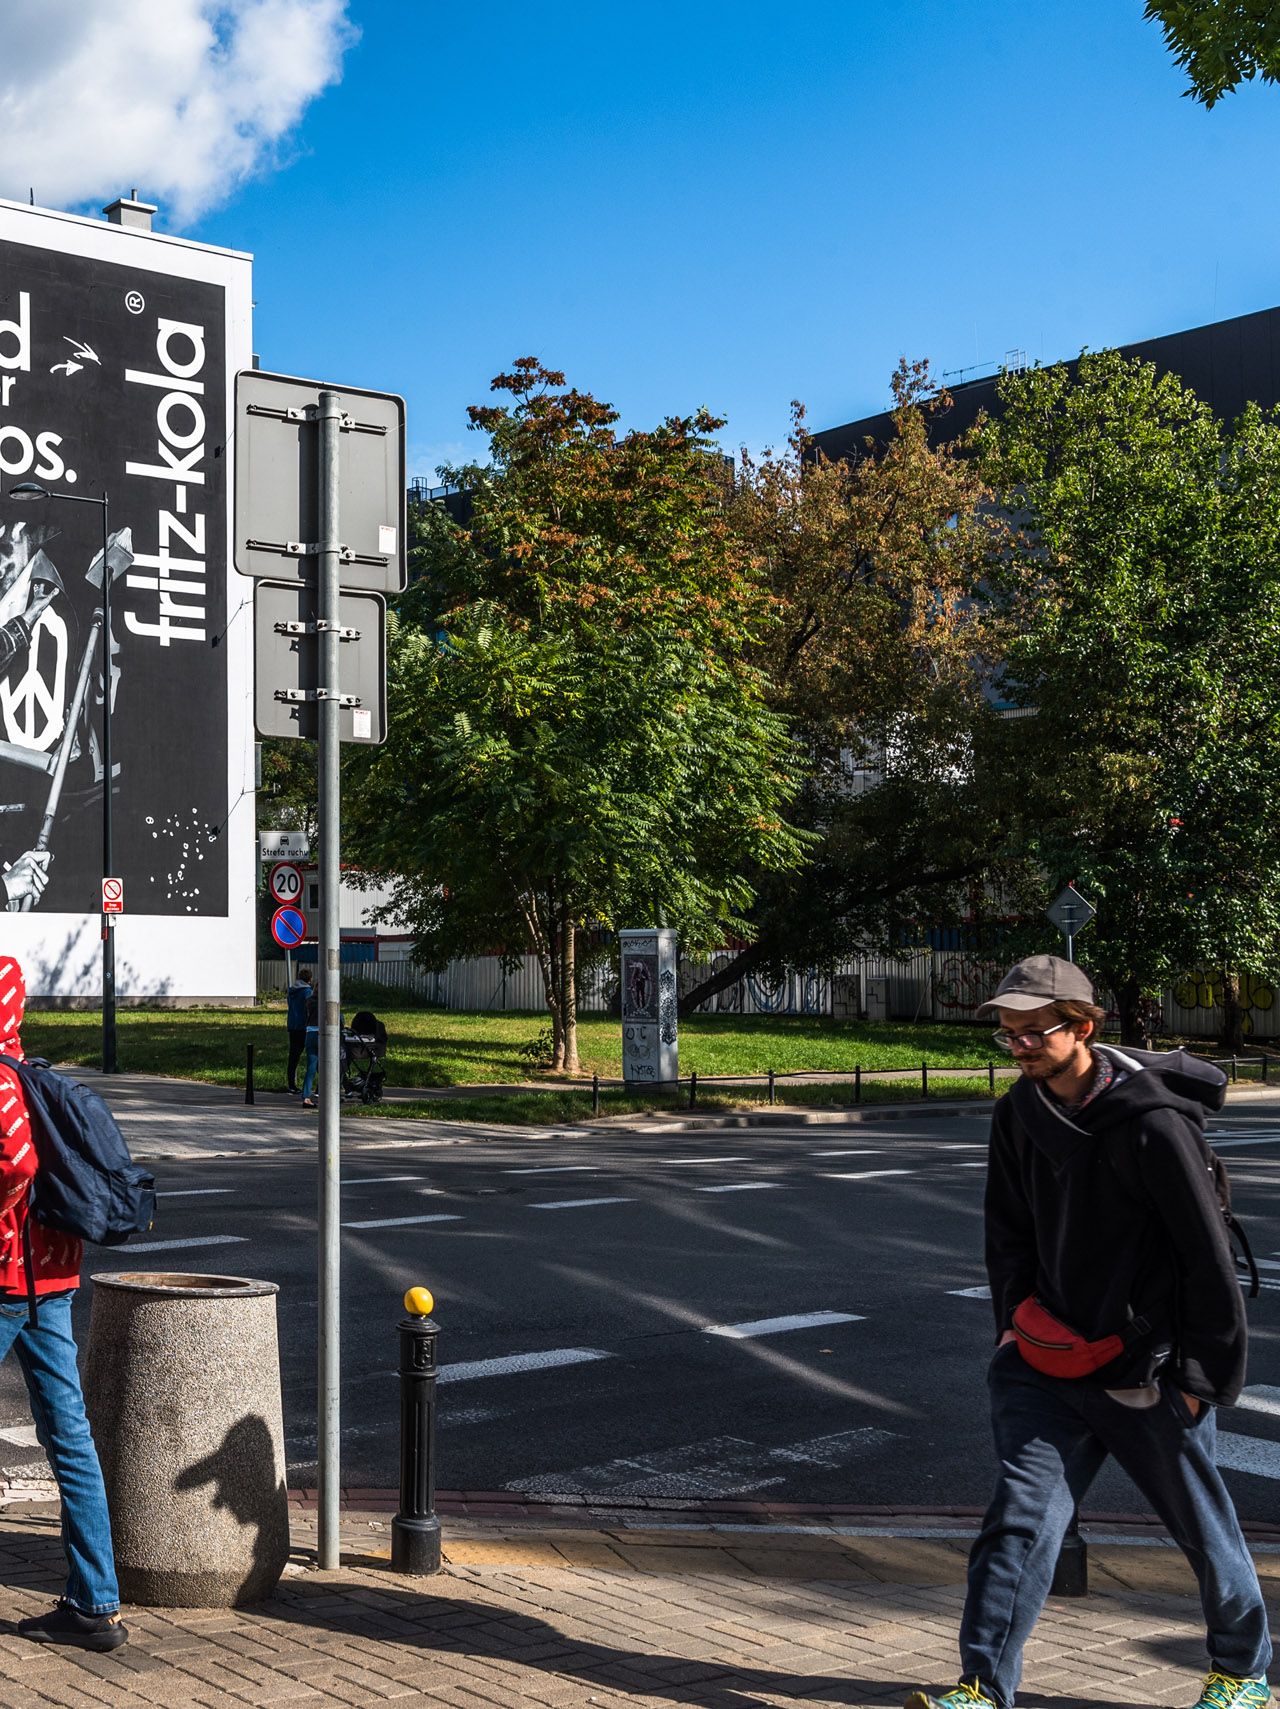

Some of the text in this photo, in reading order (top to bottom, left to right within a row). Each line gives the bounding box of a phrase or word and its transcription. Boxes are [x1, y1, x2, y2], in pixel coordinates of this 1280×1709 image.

[124, 317, 206, 647] fritz-kola
[262, 848, 309, 858] Strefa ruchu
[276, 873, 299, 894] 20
